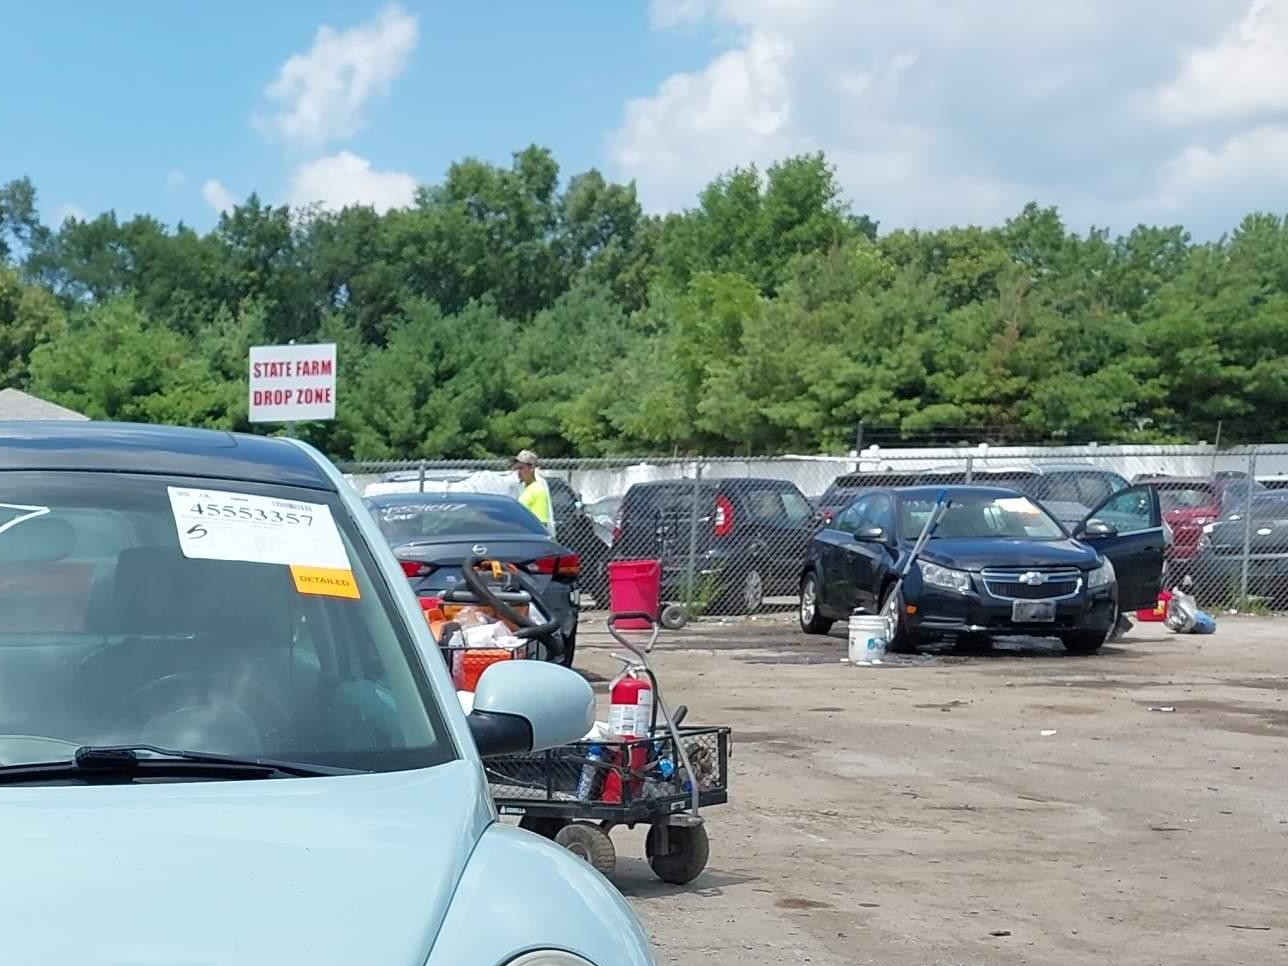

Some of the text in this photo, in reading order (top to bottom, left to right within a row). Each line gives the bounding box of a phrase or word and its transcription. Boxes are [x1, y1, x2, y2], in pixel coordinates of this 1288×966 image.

[253, 360, 332, 378] STATE FARM
[253, 388, 331, 406] DROP ZONE
[190, 502, 313, 527] 45553357
[299, 575, 350, 588] DETAILED
